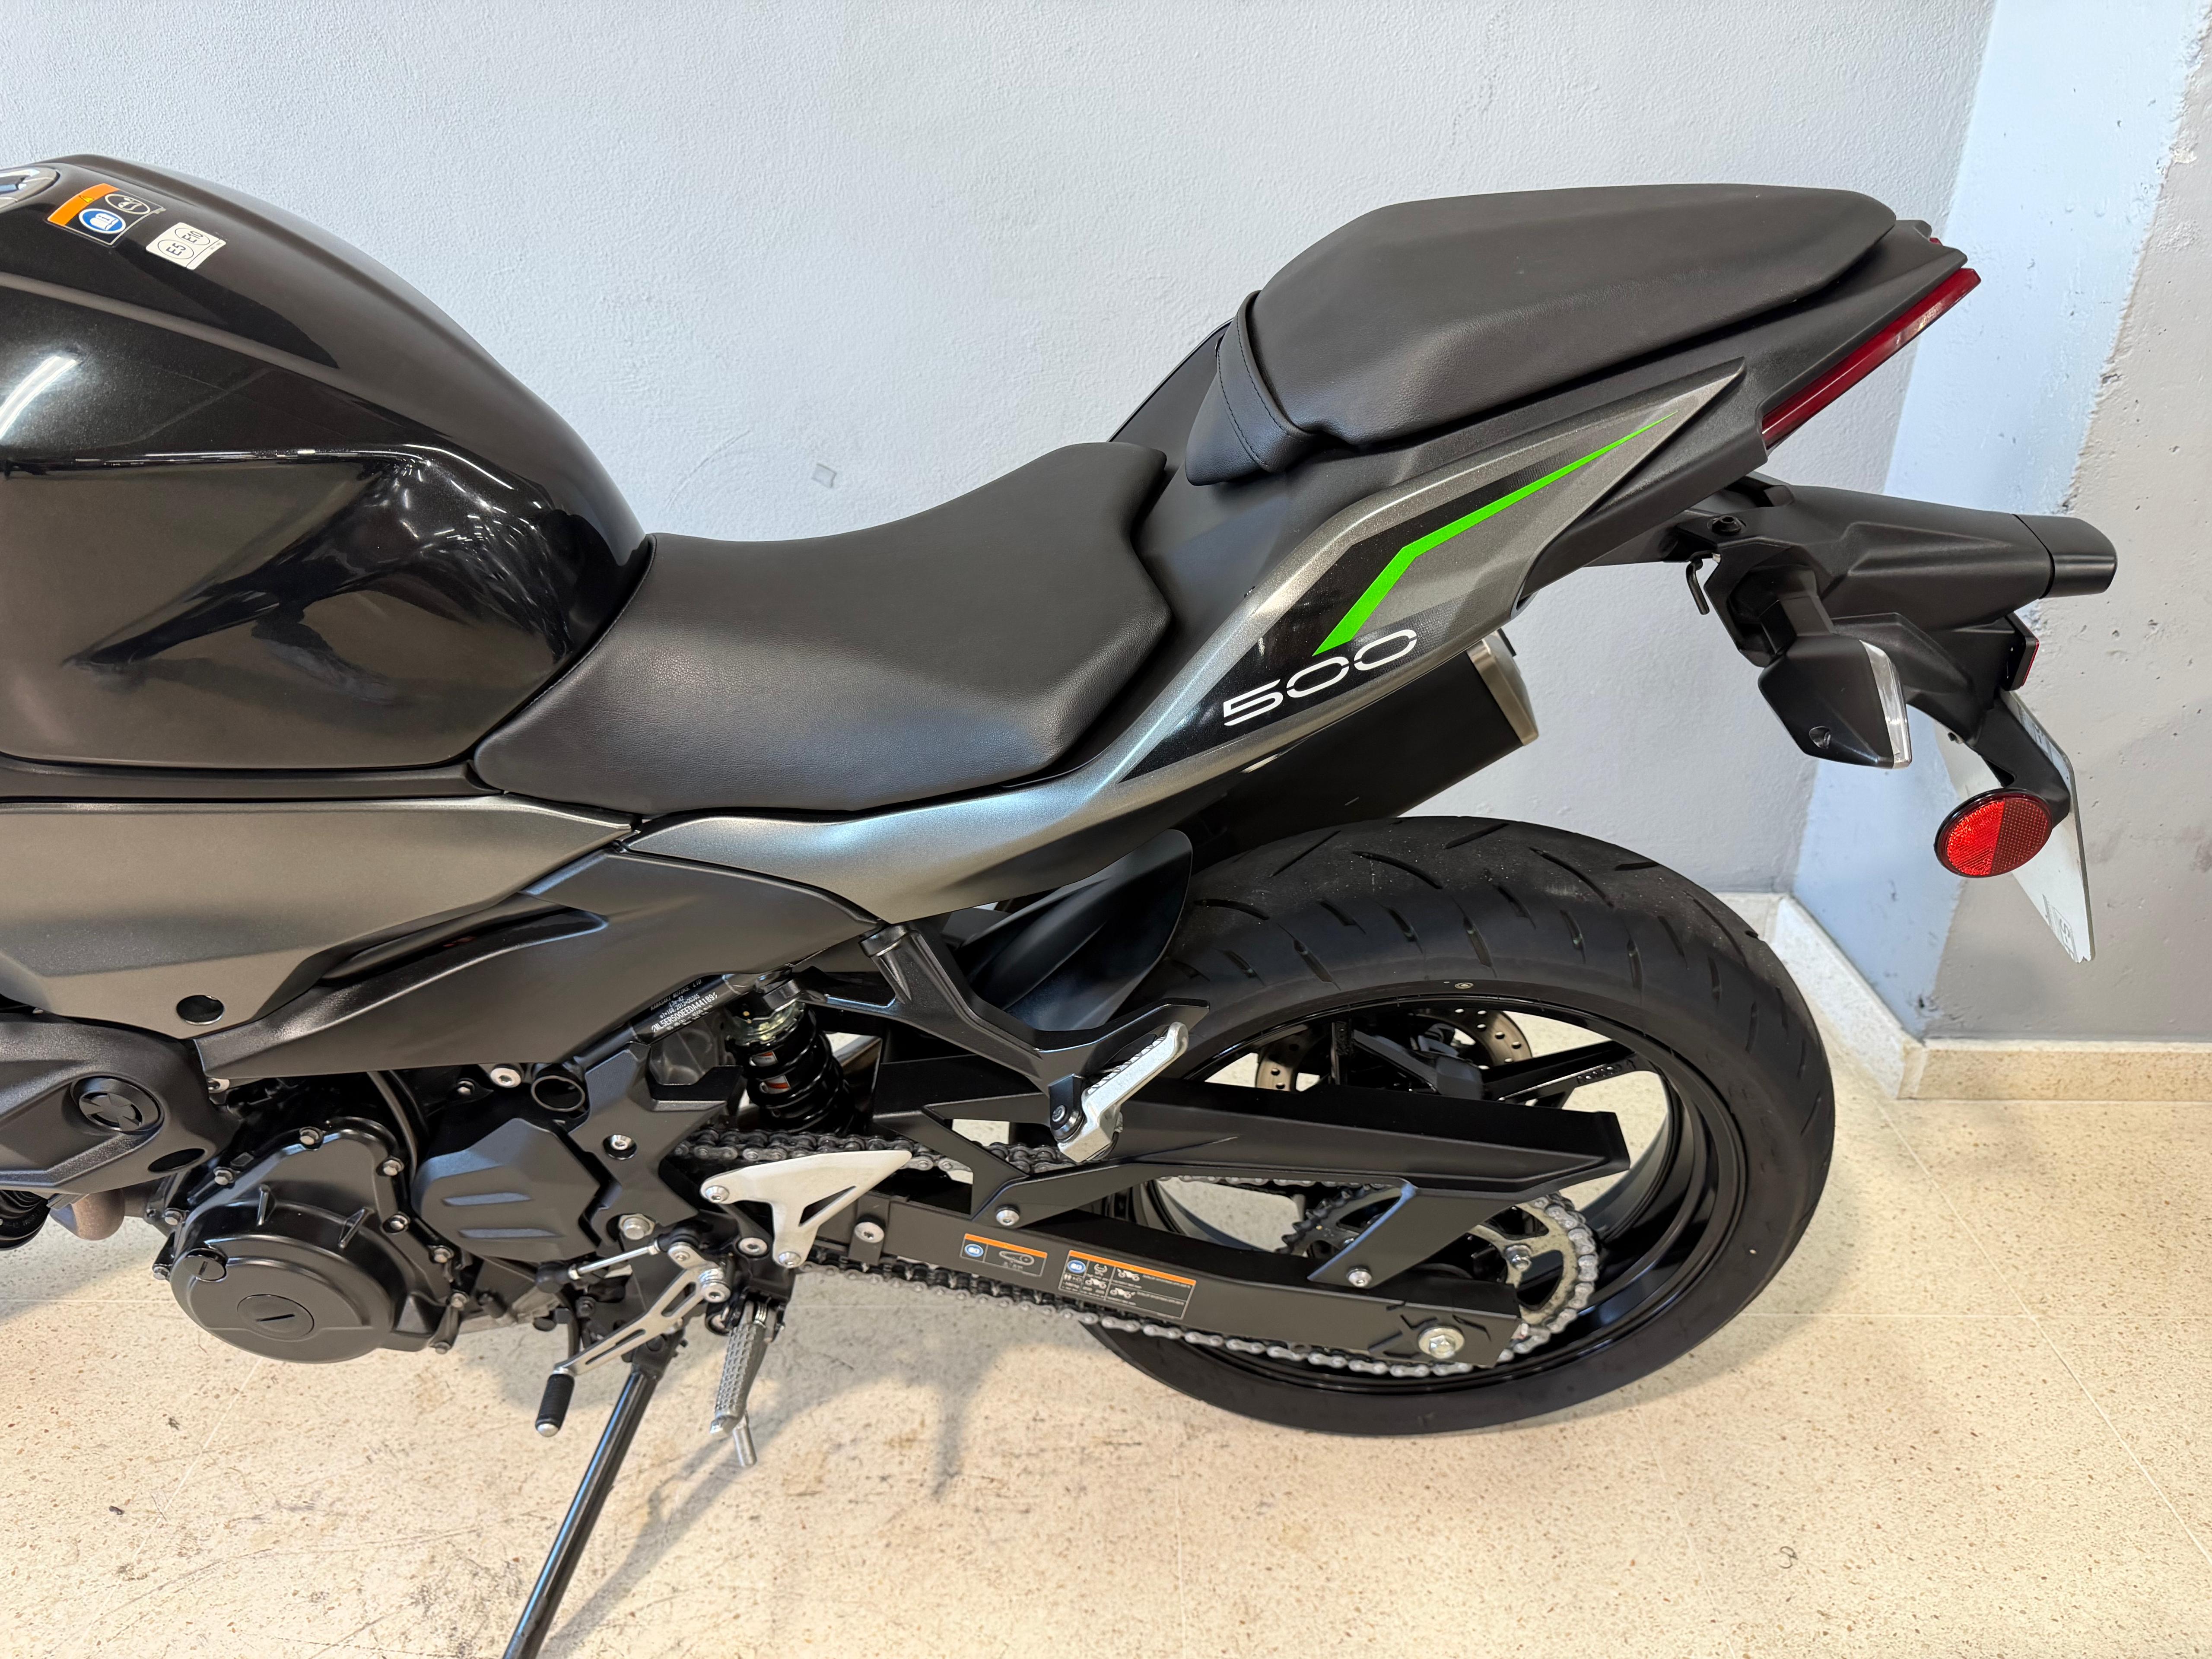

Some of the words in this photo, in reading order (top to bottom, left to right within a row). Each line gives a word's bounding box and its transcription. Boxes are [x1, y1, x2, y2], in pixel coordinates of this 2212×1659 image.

[181, 231, 203, 243] E10
[166, 243, 186, 256] E5
[1223, 629, 1417, 726] 500
